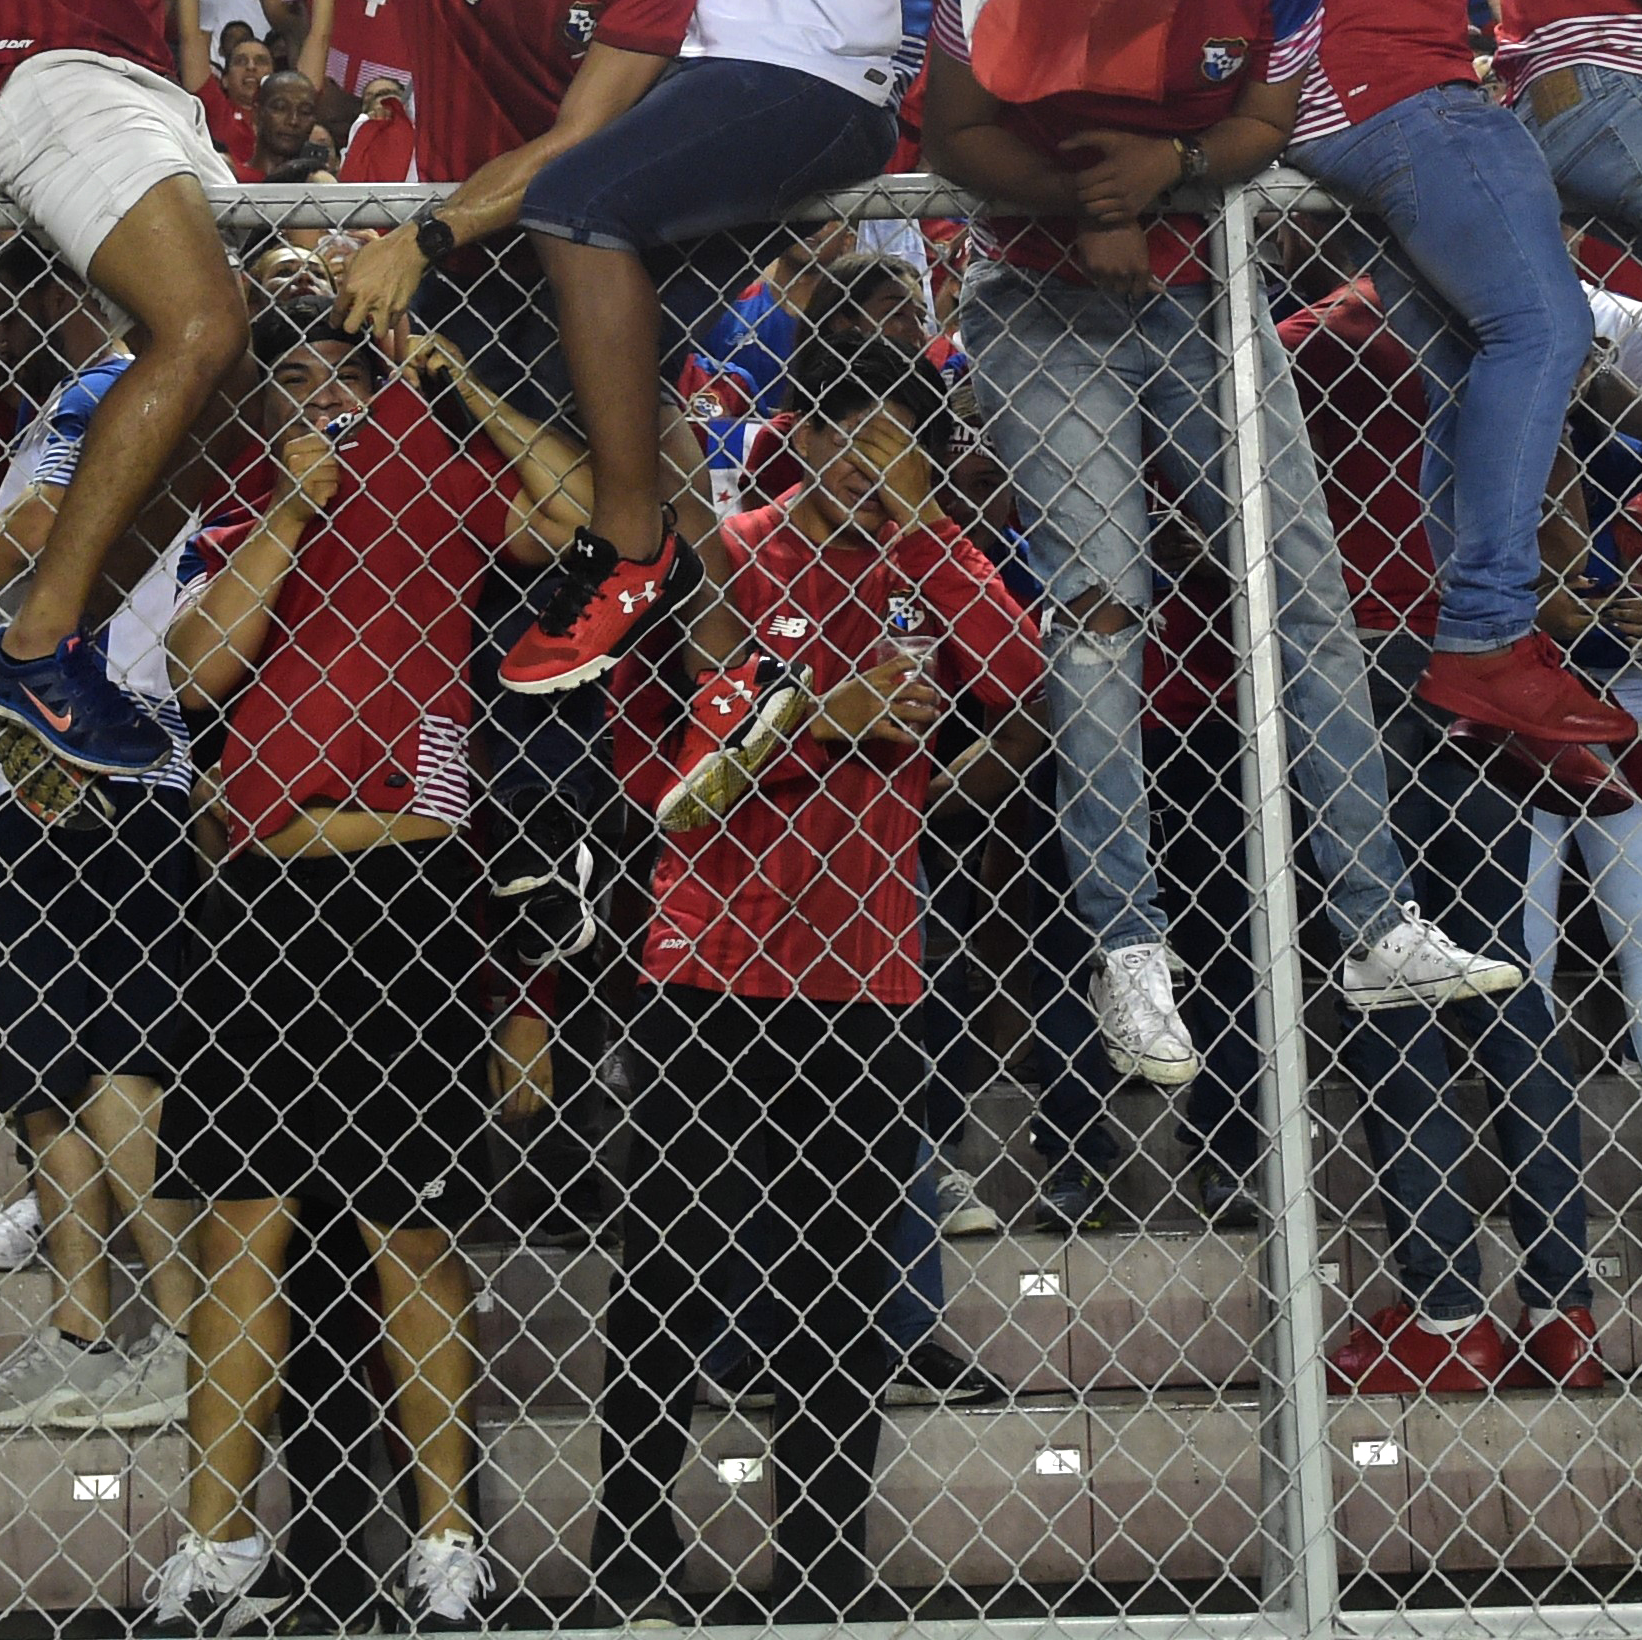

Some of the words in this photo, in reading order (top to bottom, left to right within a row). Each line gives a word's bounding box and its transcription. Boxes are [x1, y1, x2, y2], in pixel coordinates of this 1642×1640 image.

[767, 615, 808, 639] NB
[1595, 1259, 1607, 1277] 6
[733, 1461, 747, 1482] 3
